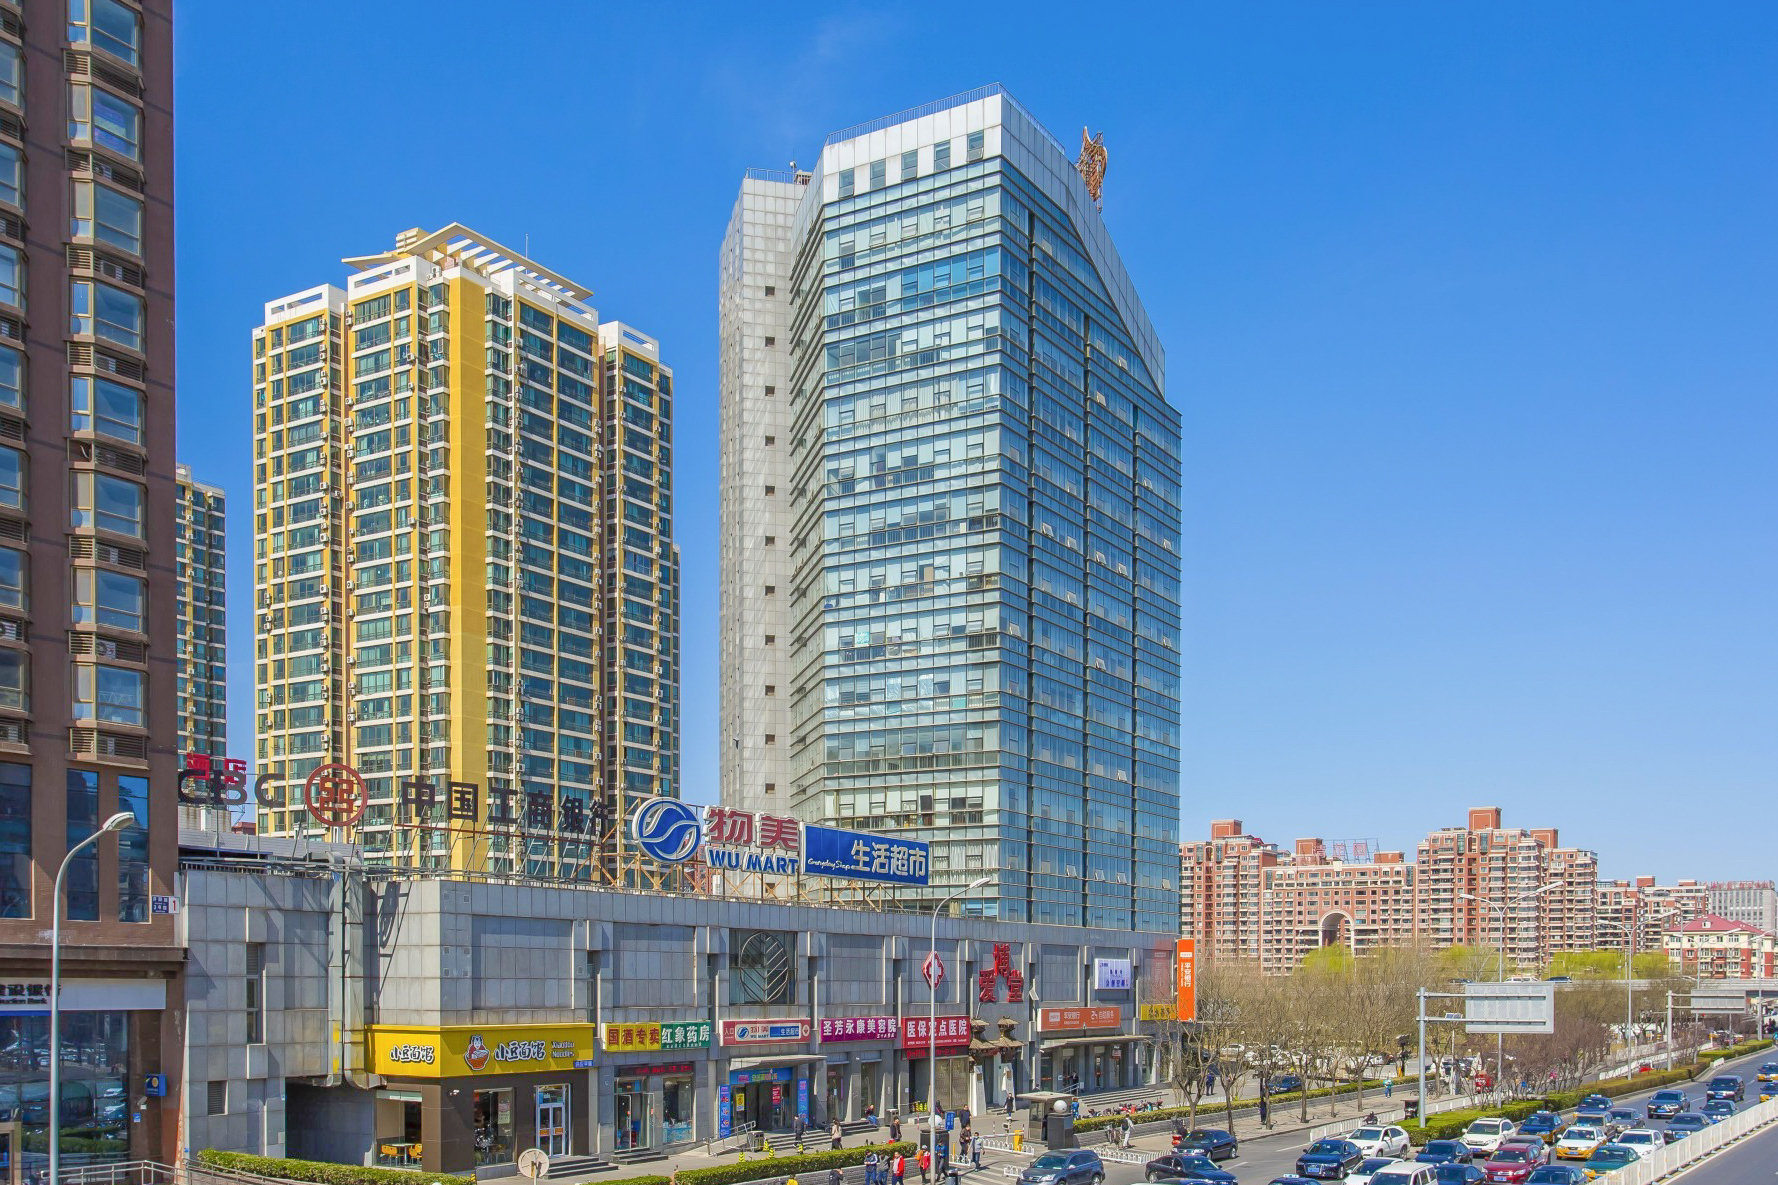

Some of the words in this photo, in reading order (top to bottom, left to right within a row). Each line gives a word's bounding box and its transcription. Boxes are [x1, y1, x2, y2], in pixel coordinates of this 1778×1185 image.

[402, 775, 608, 838] 中国工商银行
[706, 806, 799, 850] 物美
[706, 848, 741, 869] WU
[743, 853, 799, 875] MART
[851, 839, 927, 878] 生活超市
[608, 1025, 660, 1046] 国酒专卖
[661, 1024, 710, 1043] 红象药房
[823, 1019, 897, 1036] 圣芳永康美容院
[390, 1043, 435, 1064] 小豆面馆
[494, 1040, 546, 1062] 小豆面馆
